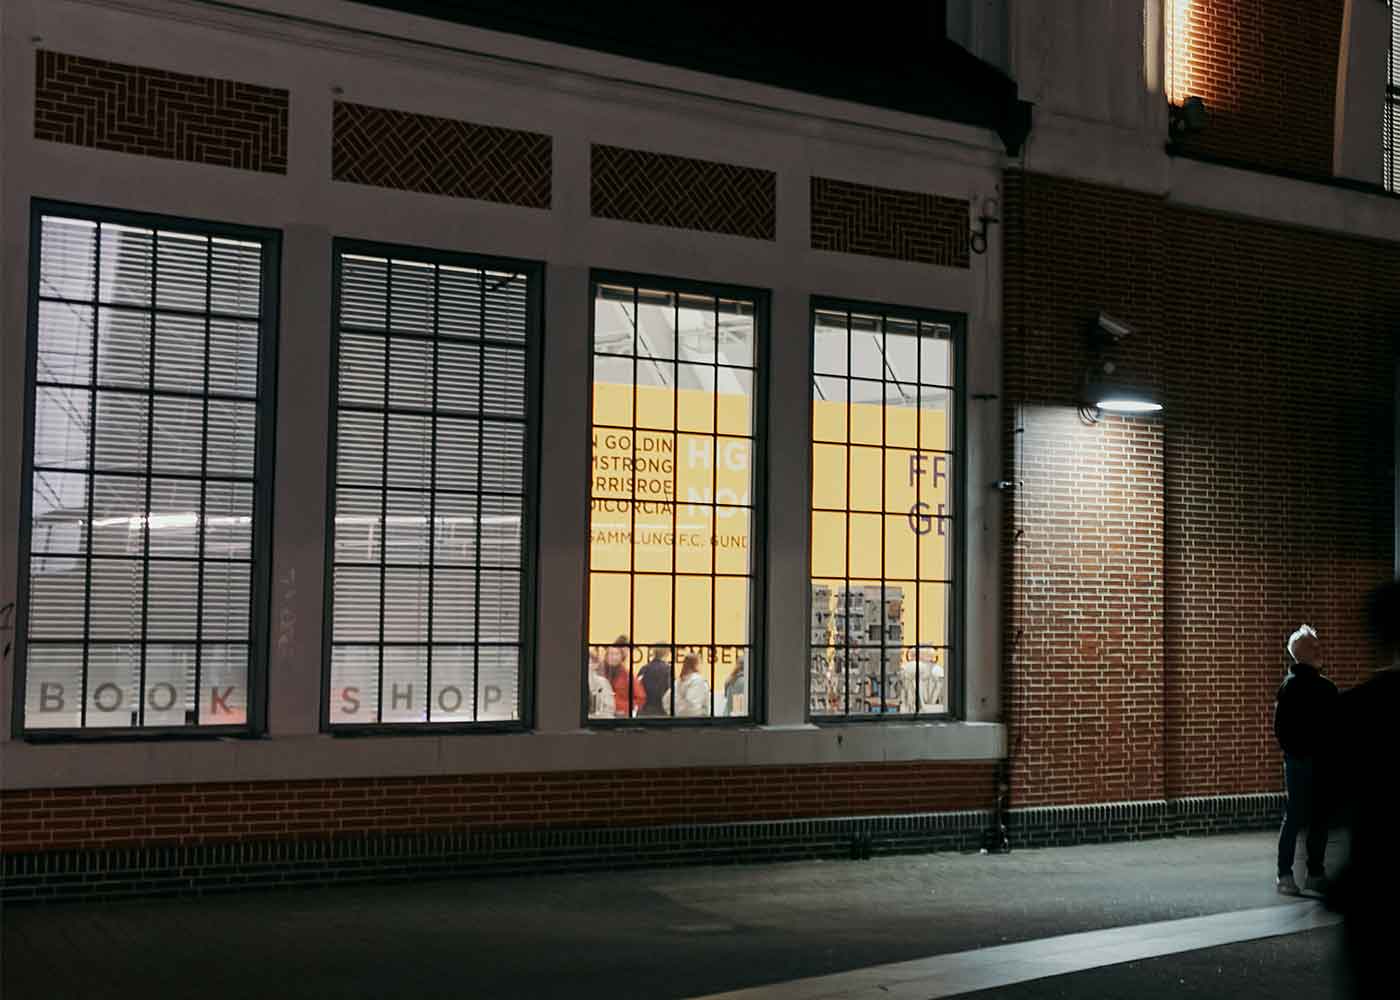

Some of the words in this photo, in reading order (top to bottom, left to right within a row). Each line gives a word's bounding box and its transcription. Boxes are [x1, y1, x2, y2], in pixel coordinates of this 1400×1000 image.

[605, 435, 673, 452] GOLDIN
[592, 476, 673, 495] RRISROE
[687, 487, 747, 518] NO
[39, 681, 235, 715] BOOK
[341, 683, 502, 714] SHOP
